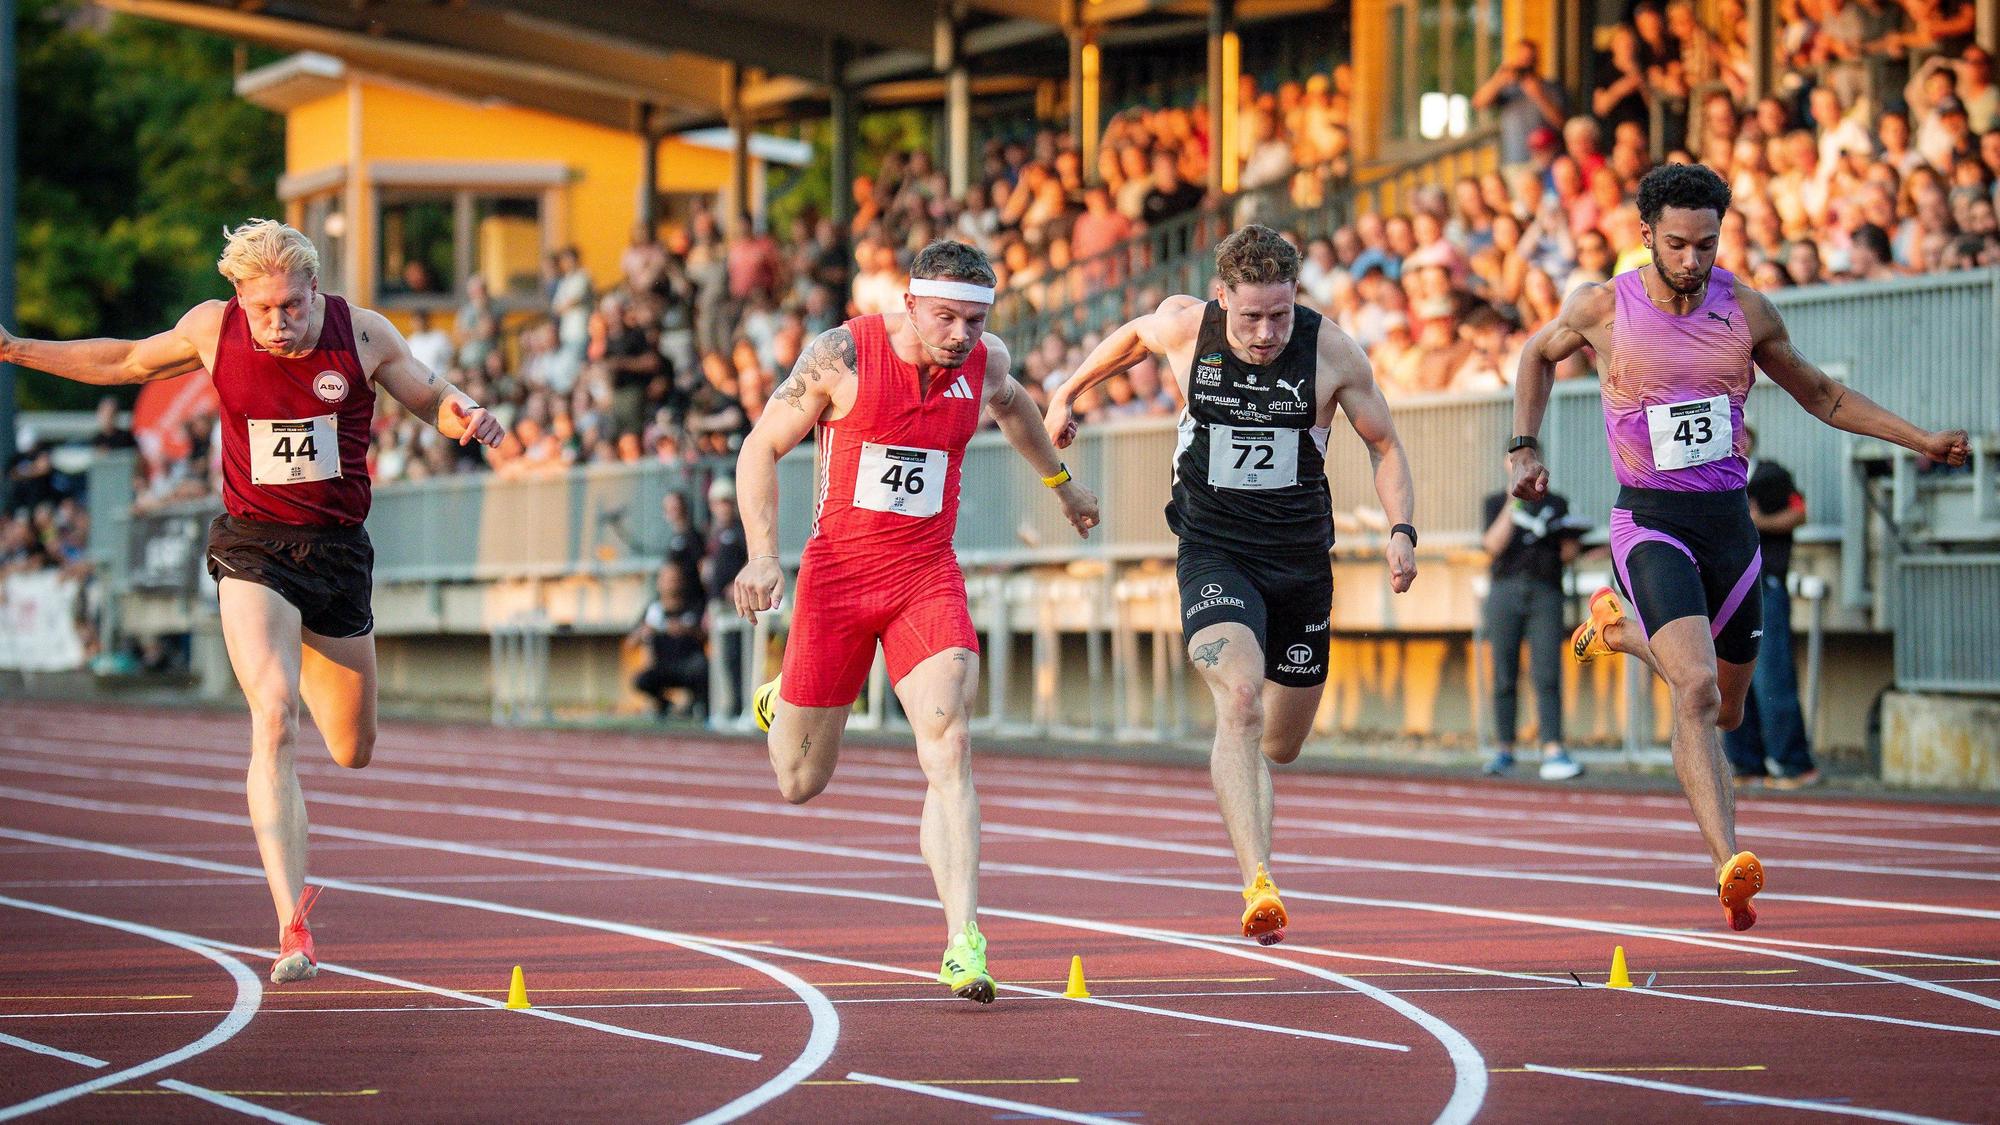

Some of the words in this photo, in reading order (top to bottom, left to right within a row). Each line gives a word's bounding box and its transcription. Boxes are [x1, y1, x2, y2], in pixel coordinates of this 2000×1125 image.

[1197, 365, 1222, 374] SPRINT
[1197, 371, 1222, 381] TEAM
[319, 383, 343, 391] ASV
[1196, 377, 1221, 387] Wetzlar
[1233, 381, 1270, 392] Bundeswehr
[1673, 416, 1713, 447] 43
[272, 435, 318, 464] 44
[1231, 443, 1275, 470] 72
[880, 464, 925, 495] 46
[1277, 663, 1321, 675] WETZLAR
